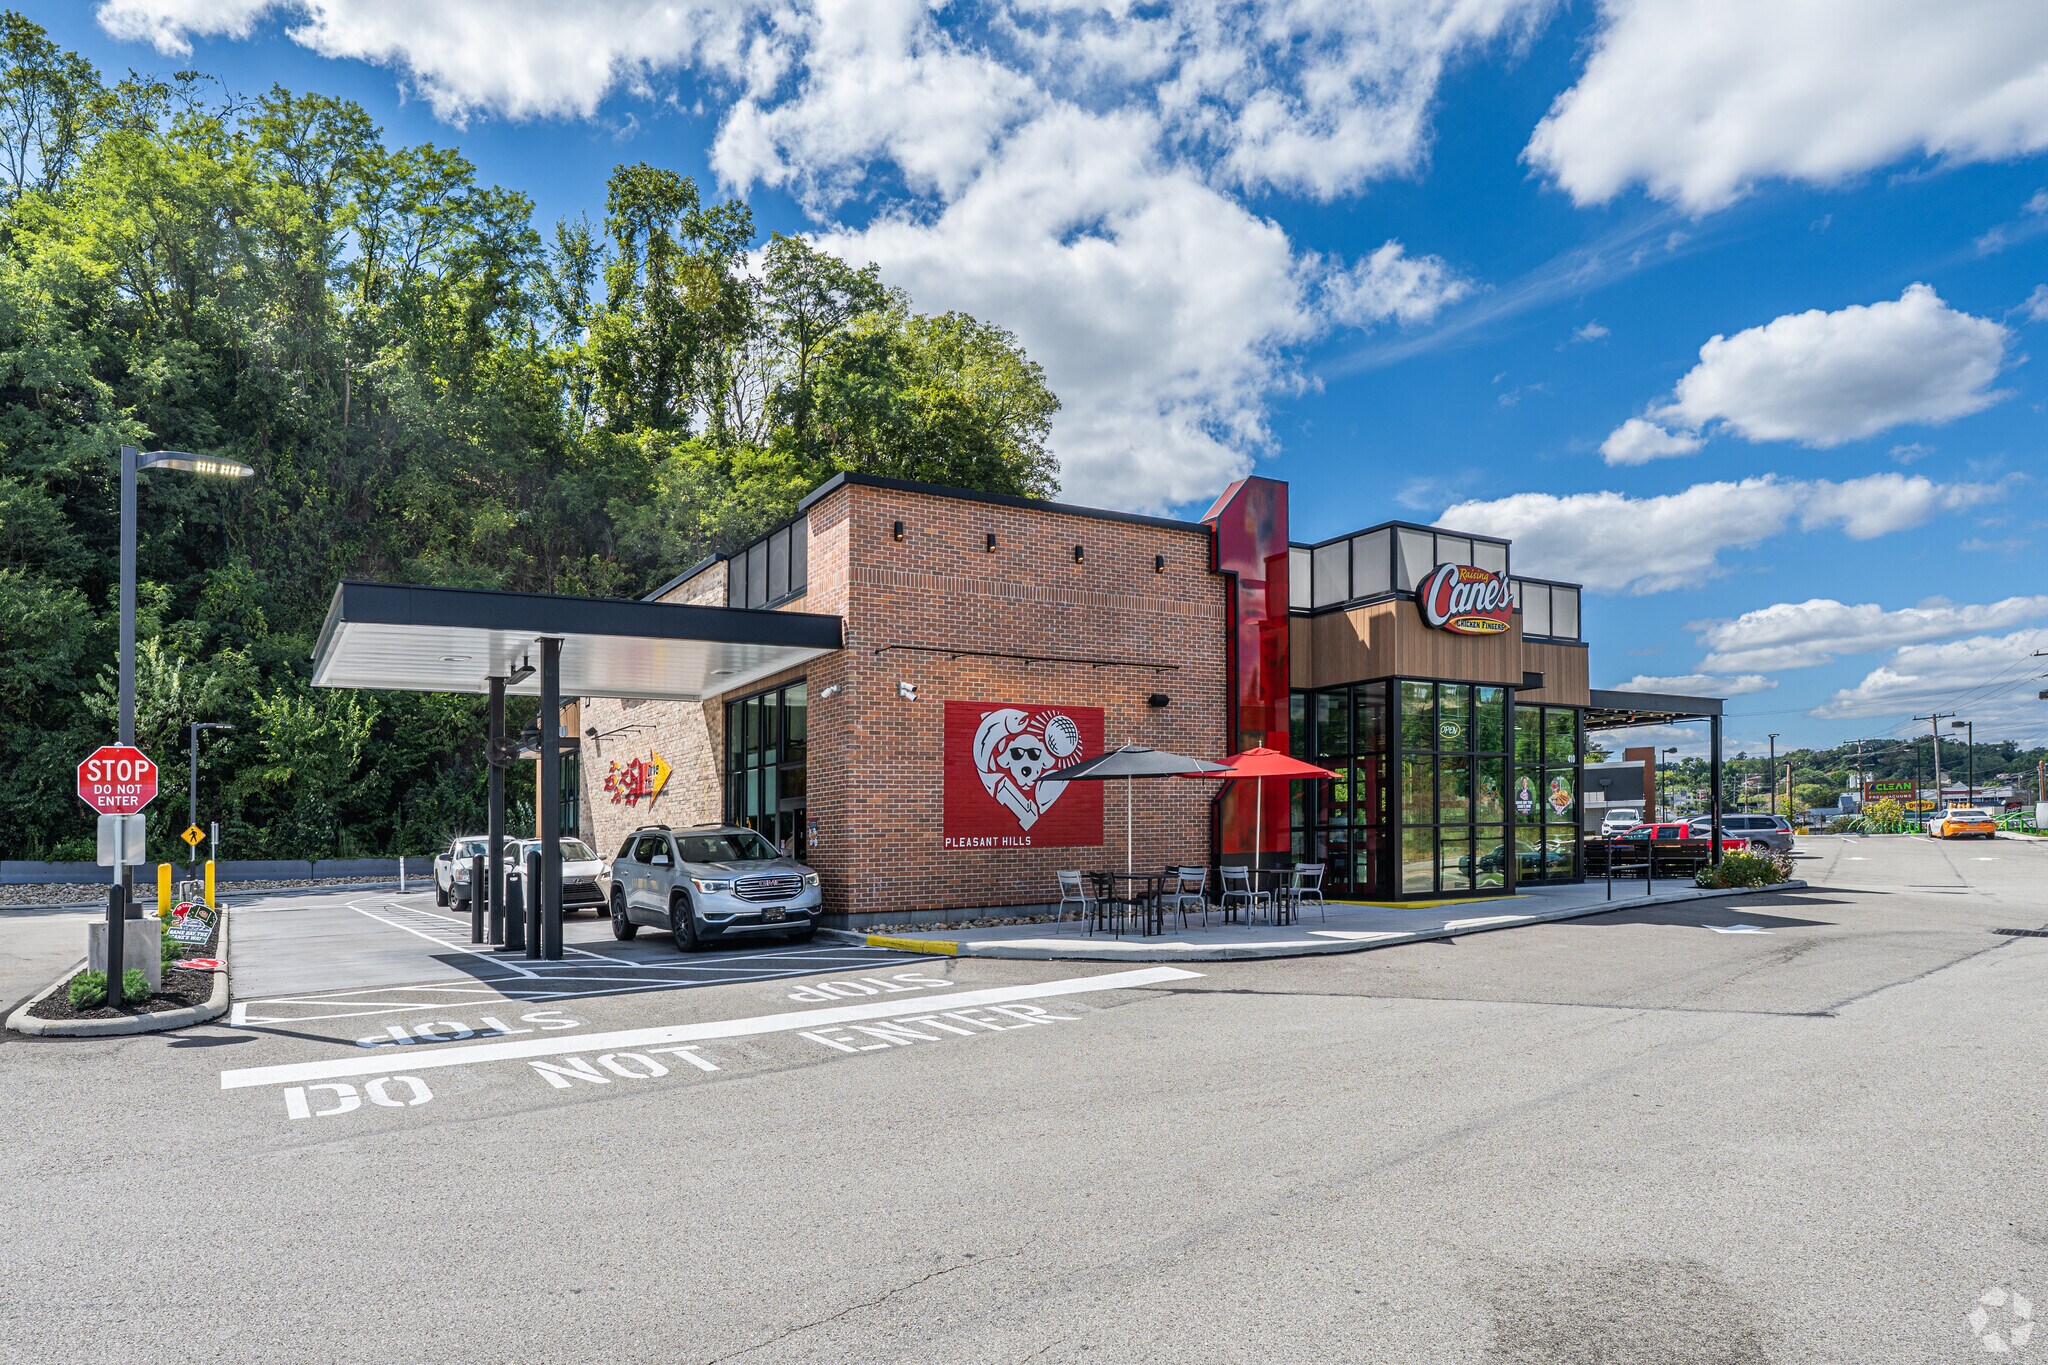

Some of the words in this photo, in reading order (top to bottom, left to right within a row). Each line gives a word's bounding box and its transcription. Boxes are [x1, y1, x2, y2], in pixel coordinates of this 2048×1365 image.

[1459, 567, 1489, 583] Raising
[1427, 563, 1514, 626] Cane's
[1456, 620, 1480, 629] CHICKEN
[1481, 621, 1505, 631] FINGERS
[1440, 725, 1458, 735] OPEN
[86, 759, 149, 782] STOP
[94, 784, 112, 795] DO
[117, 784, 142, 795] NOT
[1875, 782, 1912, 791] CLEAN
[97, 796, 139, 807] ENTER
[945, 836, 998, 848] PLEASANT
[1002, 836, 1031, 846] HILLS
[759, 879, 785, 887] GMC
[788, 973, 955, 1002] STOP
[355, 1010, 582, 1049] STOP
[284, 1075, 435, 1121] DO
[527, 1044, 722, 1089] NOT
[798, 1003, 1084, 1053] ENTER
